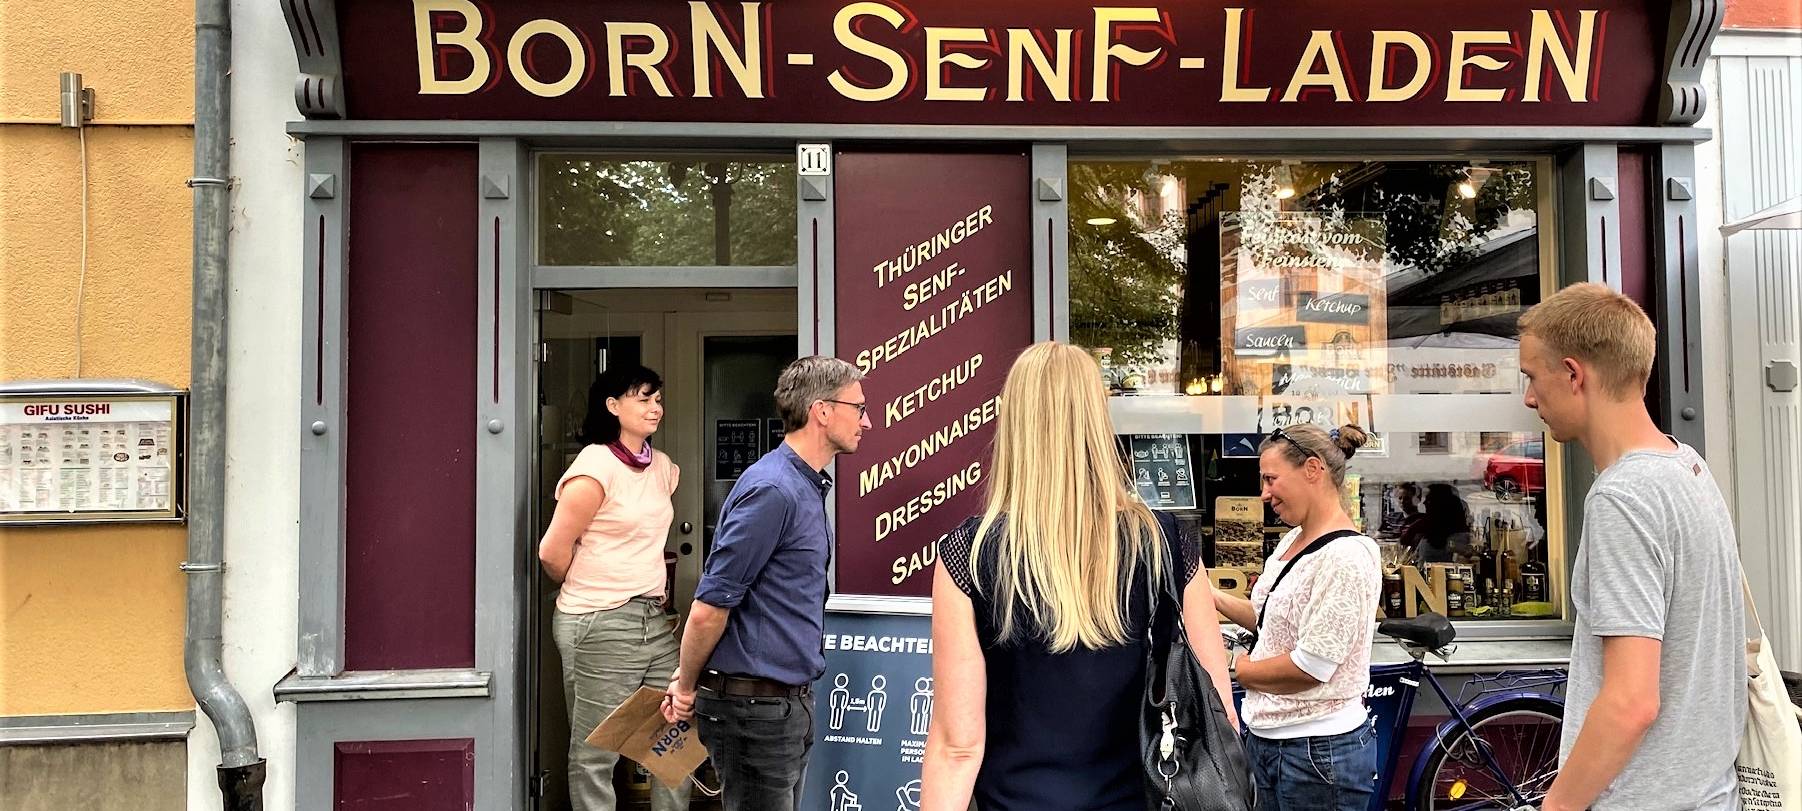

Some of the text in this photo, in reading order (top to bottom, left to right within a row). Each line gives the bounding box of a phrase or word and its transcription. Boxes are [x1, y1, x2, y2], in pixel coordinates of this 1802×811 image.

[806, 151, 823, 169] 11
[873, 204, 994, 289] THÜRINGER
[1321, 231, 1363, 246] vom
[902, 262, 966, 312] SENF-
[1248, 285, 1279, 302] Senf
[1305, 298, 1362, 314] Ketchup
[855, 269, 1013, 376] SPEZIALITÄTEN
[1245, 333, 1295, 348] Saucen
[884, 353, 983, 429] KETCHUP
[23, 403, 110, 416] GIFU SUSHI
[874, 461, 982, 542] DRESSING
[651, 719, 691, 757] BORN
[824, 735, 882, 745] ABSTAND HALTEN
[901, 755, 911, 763] IM
